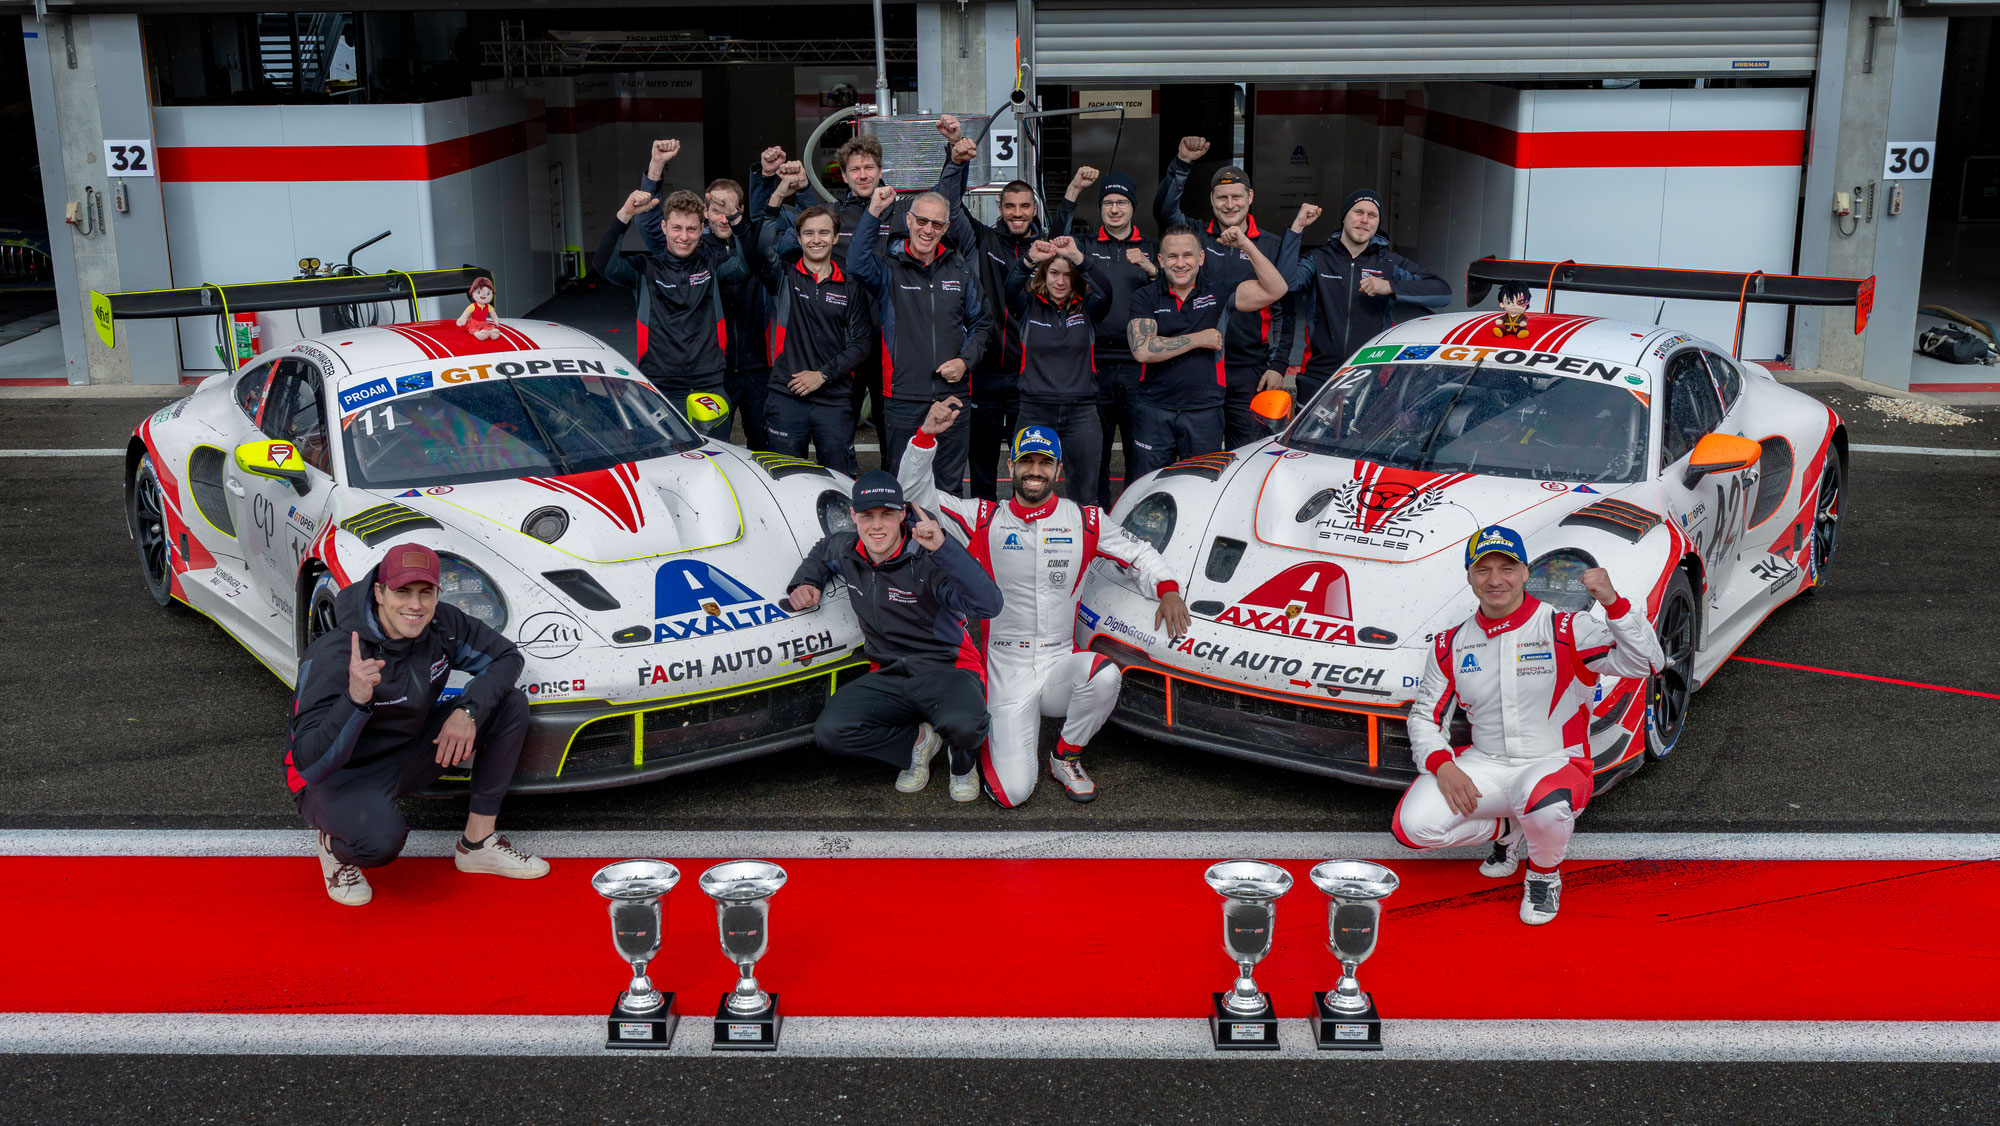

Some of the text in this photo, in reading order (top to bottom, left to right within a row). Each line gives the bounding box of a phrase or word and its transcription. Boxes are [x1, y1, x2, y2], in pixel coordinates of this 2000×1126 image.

[622, 80, 693, 88] FACH AUTO TECH
[110, 145, 148, 171] 32
[996, 135, 1018, 161] 3
[1888, 147, 1930, 174] 30
[1368, 350, 1385, 359] AM
[1330, 369, 1373, 390] 12
[344, 383, 388, 405] PROAM
[358, 405, 395, 436] 11
[1020, 438, 1051, 447] MICHELIN
[1026, 507, 1046, 519] HRX
[1315, 518, 1424, 543] HUDSON
[1319, 531, 1409, 551] STABLES
[1477, 540, 1514, 549] MICHELIN
[654, 602, 791, 643] AXALTA
[1103, 615, 1157, 647] DigitoGroup
[1215, 606, 1356, 645] AXALTA
[1488, 621, 1511, 634] HRX
[1559, 612, 1571, 634] HRX
[638, 630, 833, 686] FACH AUTO TECH
[1168, 635, 1386, 686] FACH AUTO TECH
